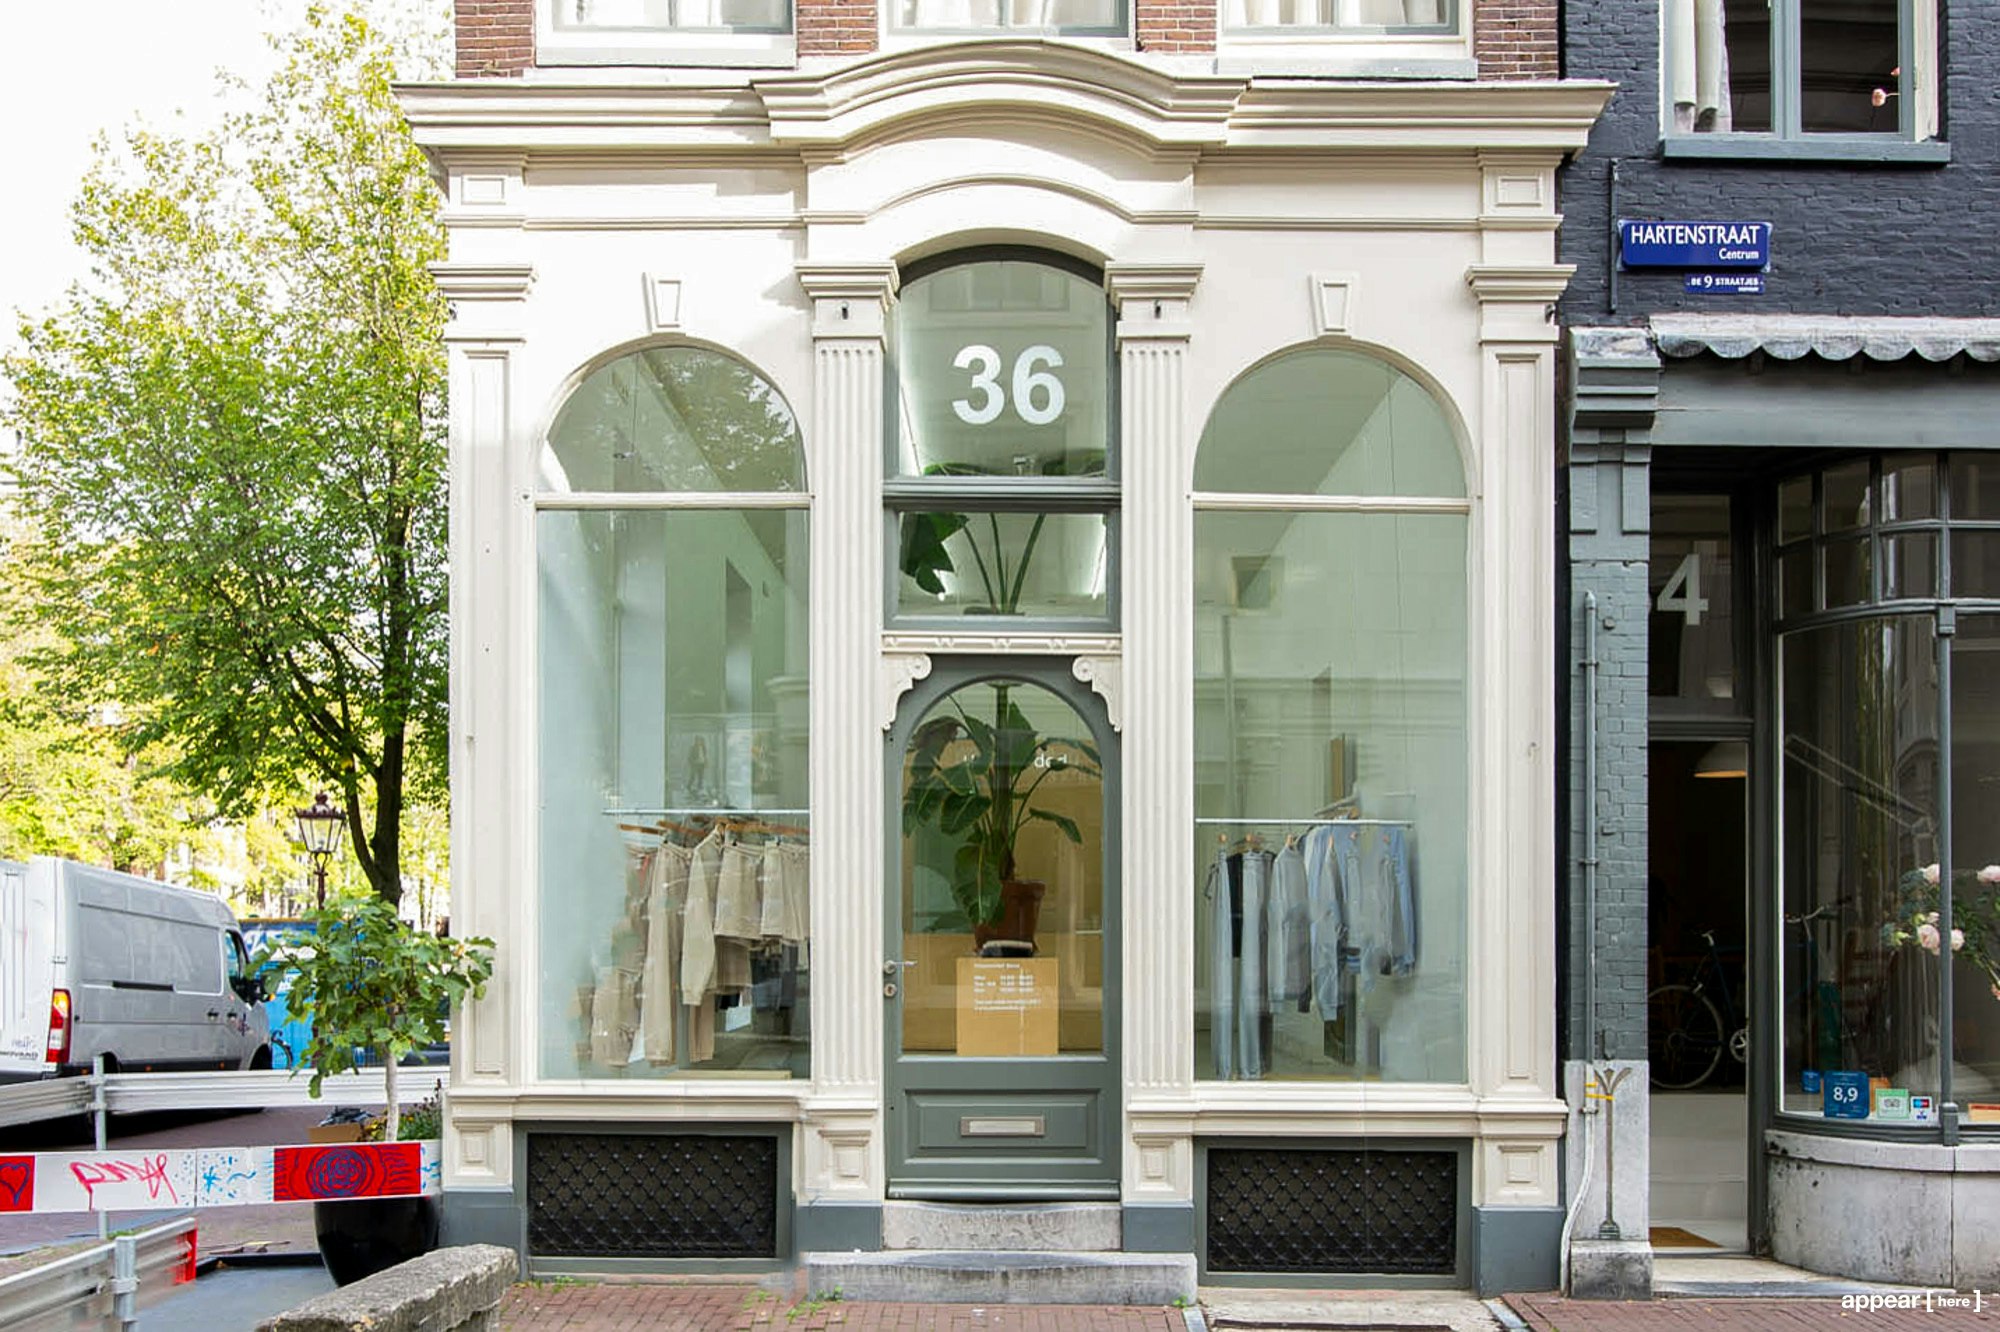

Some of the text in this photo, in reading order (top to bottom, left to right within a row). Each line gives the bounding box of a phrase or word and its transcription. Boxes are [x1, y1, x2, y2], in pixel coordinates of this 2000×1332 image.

[1631, 225, 1760, 245] HARTENSTRAAT
[1718, 248, 1759, 260] Centrum
[1703, 275, 1713, 288] 9
[951, 345, 1065, 425] 36
[1657, 553, 1709, 626] 4
[1832, 1086, 1859, 1104] 8,9
